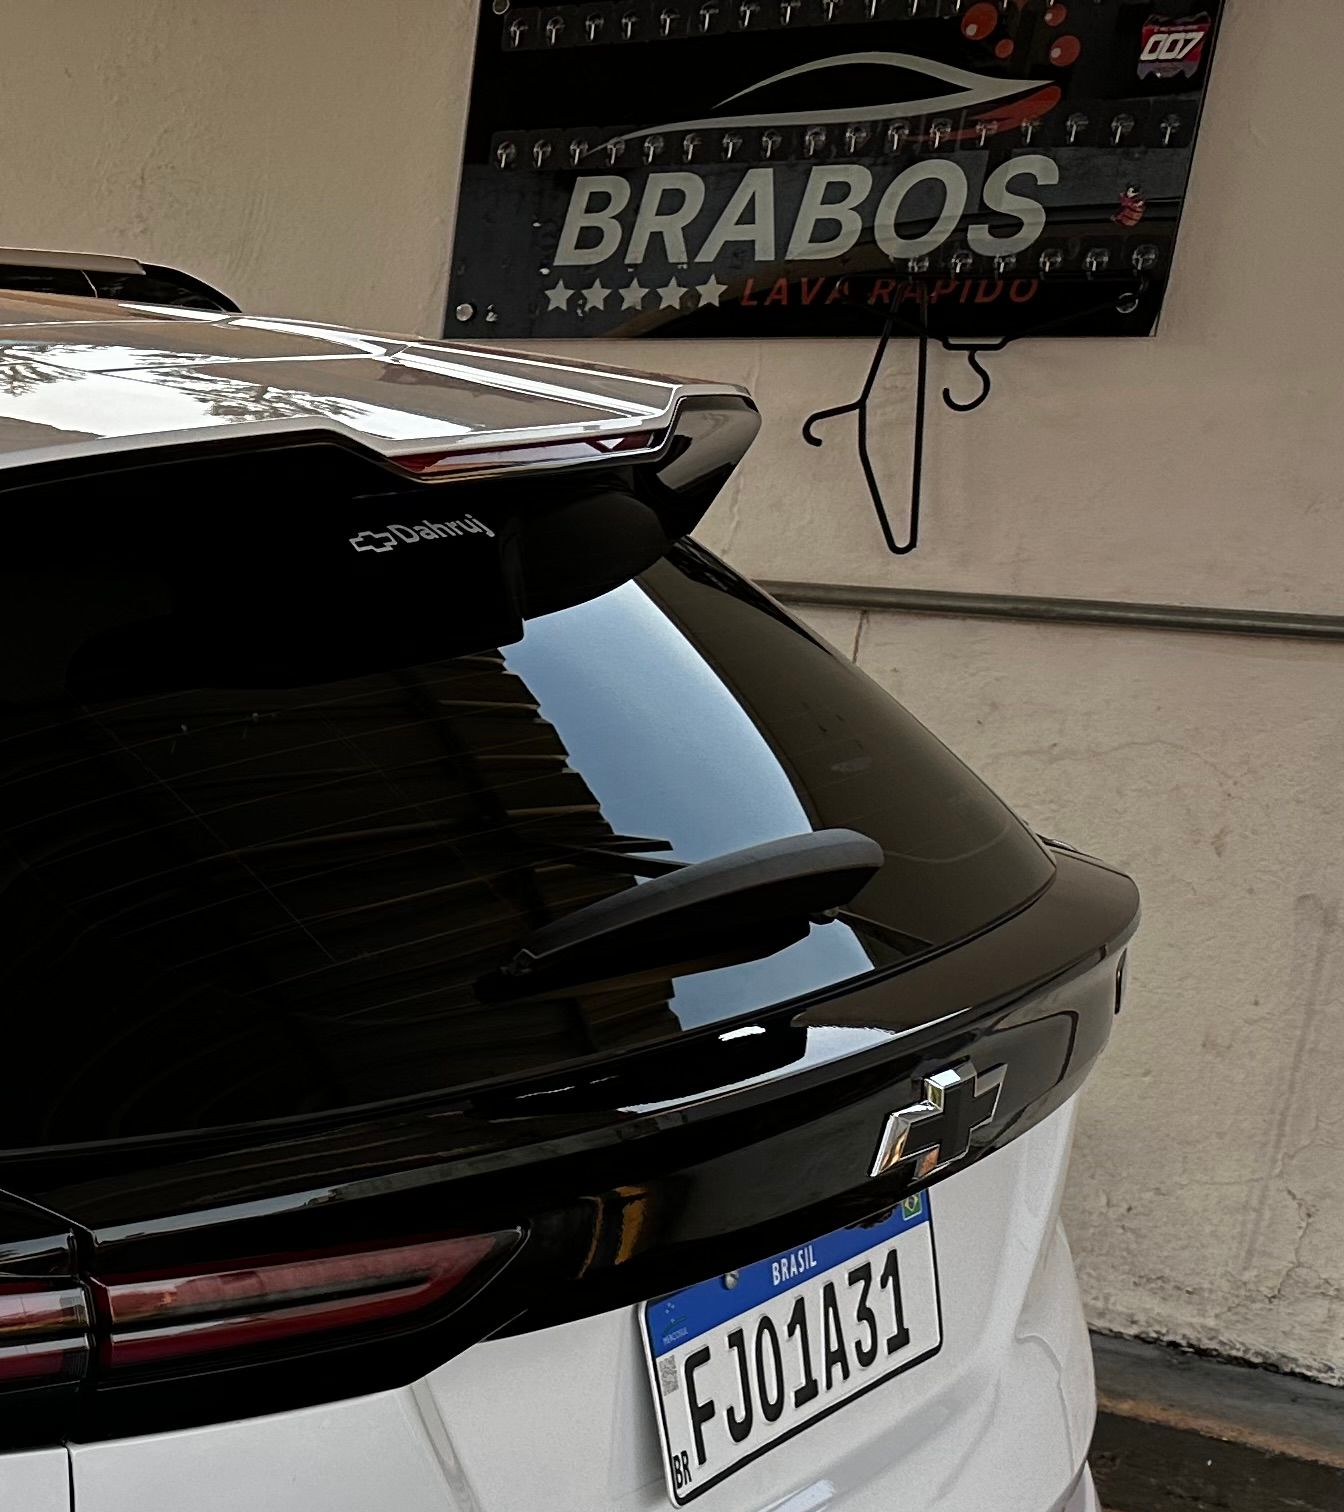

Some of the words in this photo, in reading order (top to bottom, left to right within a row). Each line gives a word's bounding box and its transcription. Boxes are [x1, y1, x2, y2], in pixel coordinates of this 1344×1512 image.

[1139, 32, 1205, 60] 007
[554, 155, 1059, 267] BRABOS
[387, 514, 495, 543] Dahruj
[771, 1245, 817, 1286] BRASIL
[684, 1249, 910, 1465] FJ01A31
[672, 1450, 692, 1489] BR
